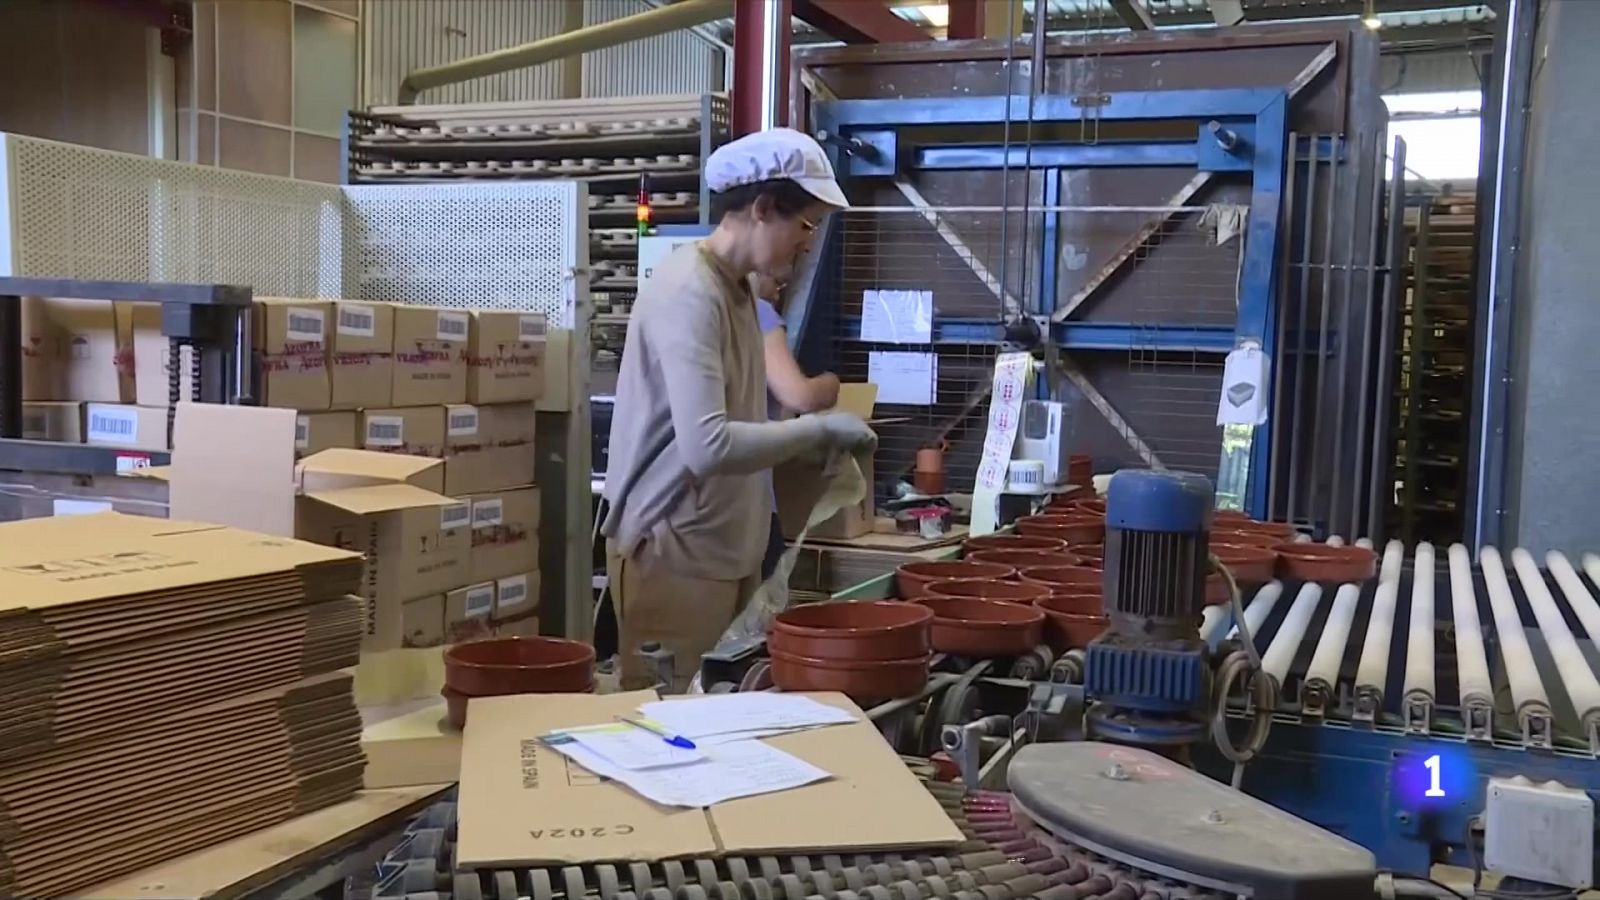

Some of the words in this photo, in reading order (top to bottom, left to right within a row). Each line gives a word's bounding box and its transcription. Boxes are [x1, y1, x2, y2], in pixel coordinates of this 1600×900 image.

[368, 521, 379, 566] SPAIN
[368, 569, 378, 586] IN
[367, 590, 377, 636] MADE
[520, 739, 537, 758] MADE
[520, 759, 537, 767] IN
[521, 768, 539, 789] SPAIN
